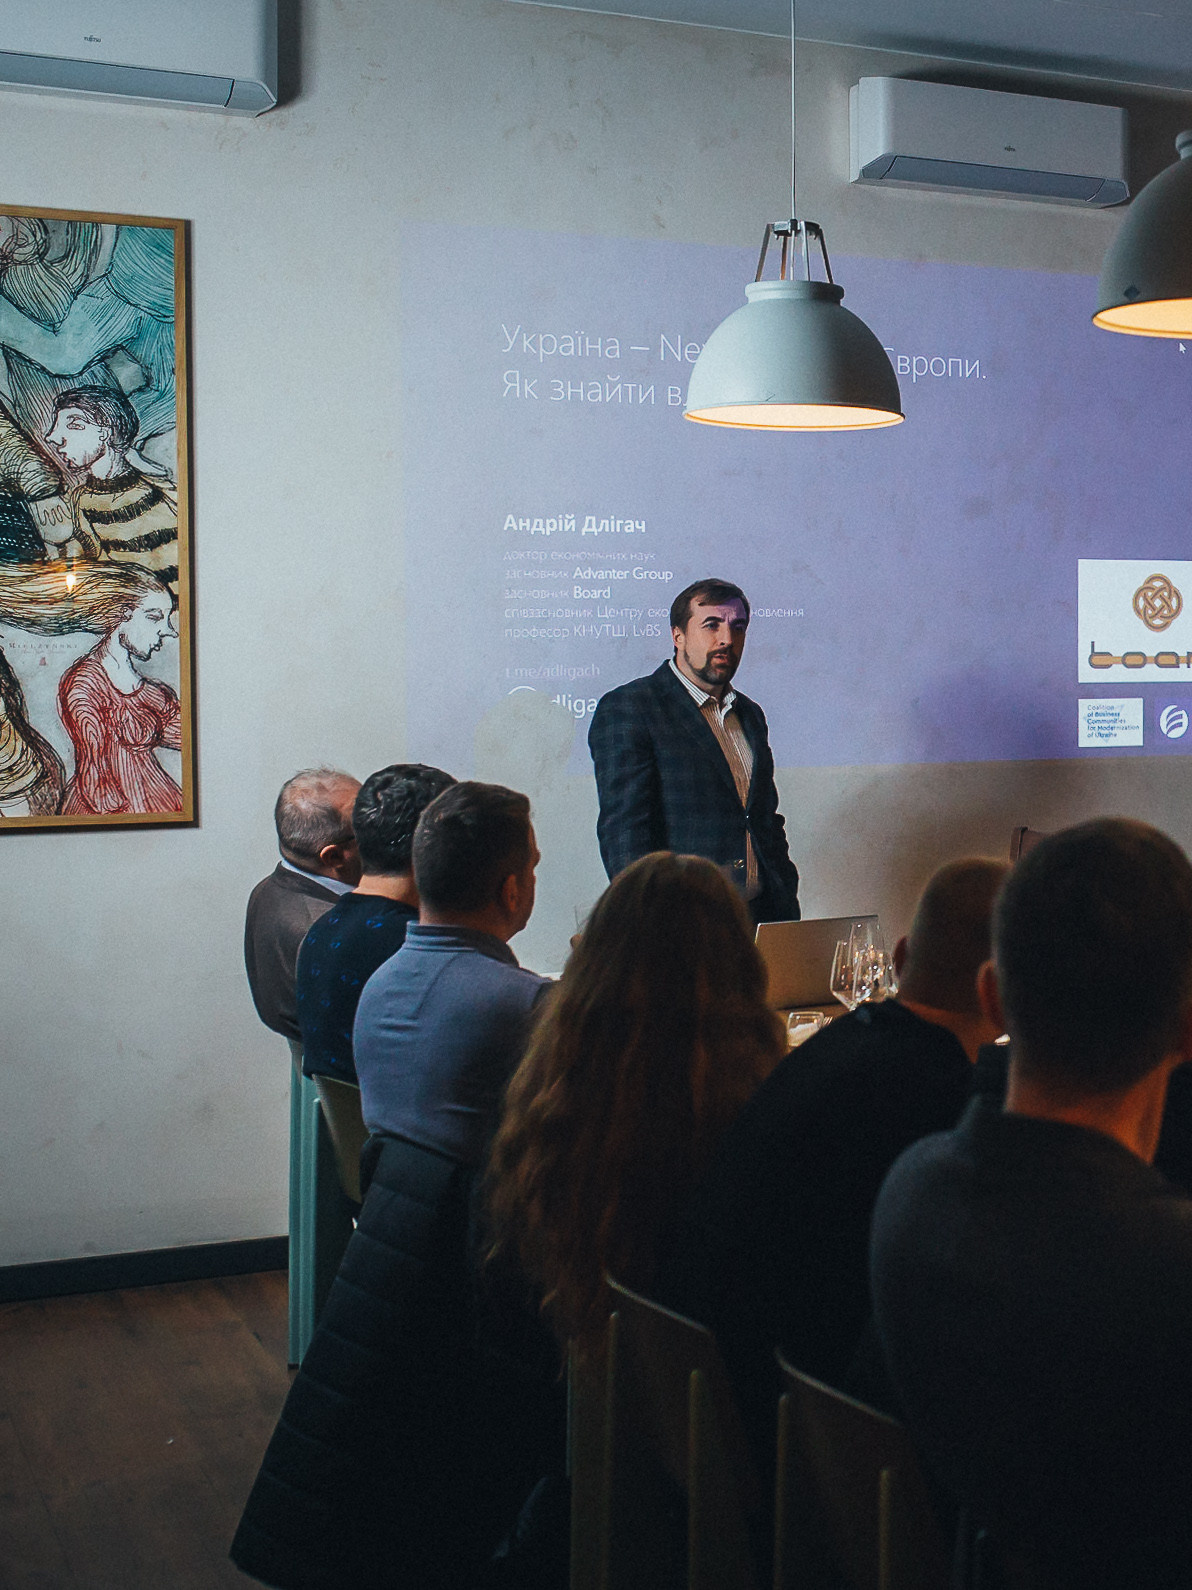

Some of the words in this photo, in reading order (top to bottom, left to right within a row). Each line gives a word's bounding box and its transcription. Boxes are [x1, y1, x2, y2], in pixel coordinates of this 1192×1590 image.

[502, 323, 620, 363] Україна
[660, 333, 707, 363] Ne
[883, 347, 987, 383] вропи.
[502, 370, 538, 400] Як
[550, 374, 655, 405] знайти
[503, 514, 576, 536] Андрій
[581, 515, 646, 536] Длігач
[503, 551, 547, 563] доктор
[573, 566, 629, 580] Advanter
[633, 567, 674, 583] Group
[573, 586, 611, 599] Board
[597, 605, 643, 620] Центру
[648, 608, 670, 618] еко
[504, 625, 570, 639] професор
[633, 624, 661, 637] LvBS
